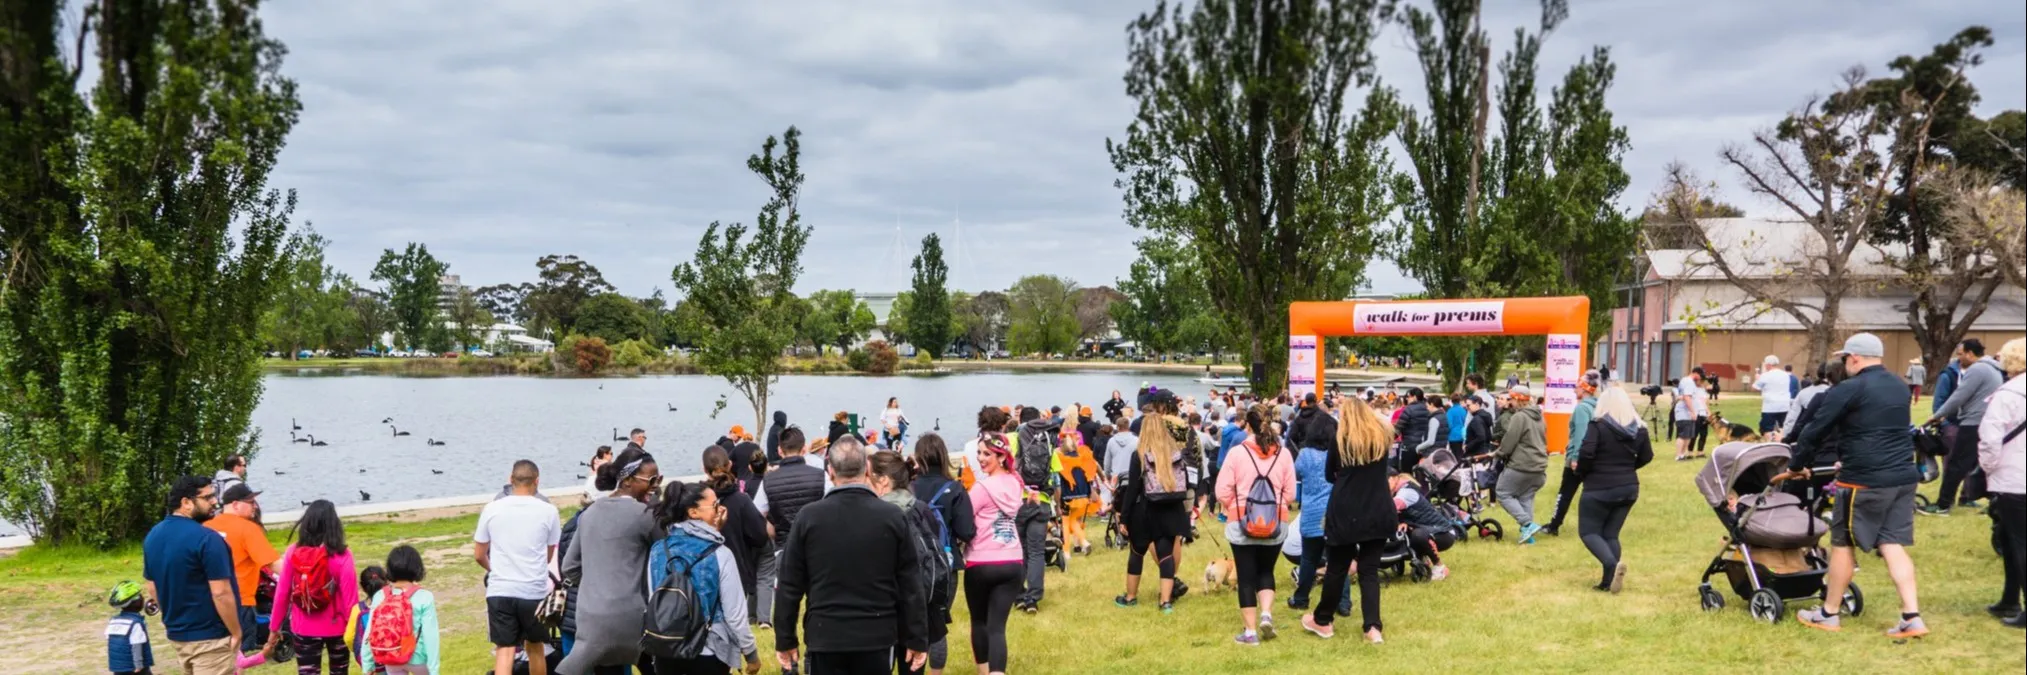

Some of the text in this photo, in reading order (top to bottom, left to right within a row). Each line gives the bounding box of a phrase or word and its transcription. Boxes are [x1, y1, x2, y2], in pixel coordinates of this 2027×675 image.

[1367, 310, 1497, 326] walk for prems
